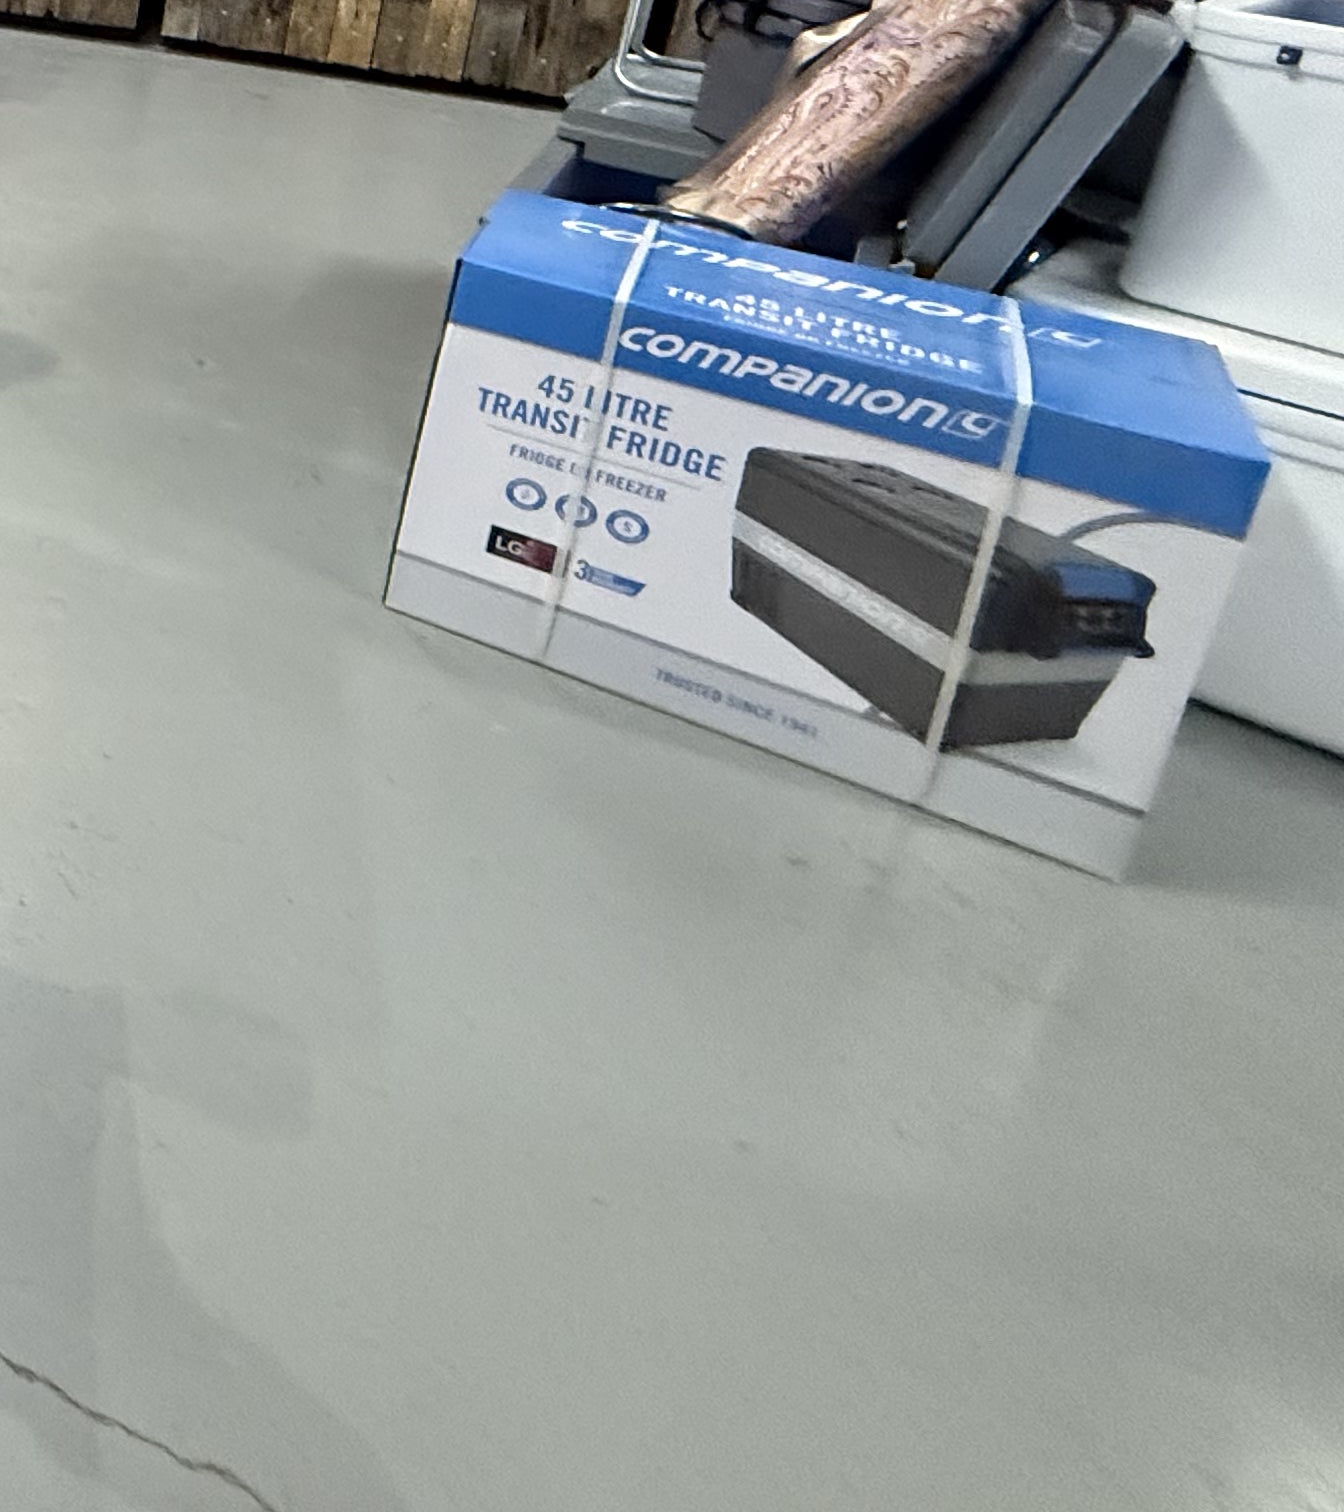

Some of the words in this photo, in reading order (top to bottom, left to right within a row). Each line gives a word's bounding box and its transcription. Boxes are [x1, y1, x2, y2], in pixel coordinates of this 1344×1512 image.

[665, 286, 815, 330] TRANSIT
[830, 327, 984, 373] FRIDGE
[795, 306, 901, 340] LITRE
[537, 375, 575, 403] 45
[478, 387, 590, 438] TRANSI
[606, 425, 728, 481] FRIDGE
[510, 443, 566, 473] FRIDGE
[596, 469, 667, 502] FREEZER
[495, 535, 523, 556] LG
